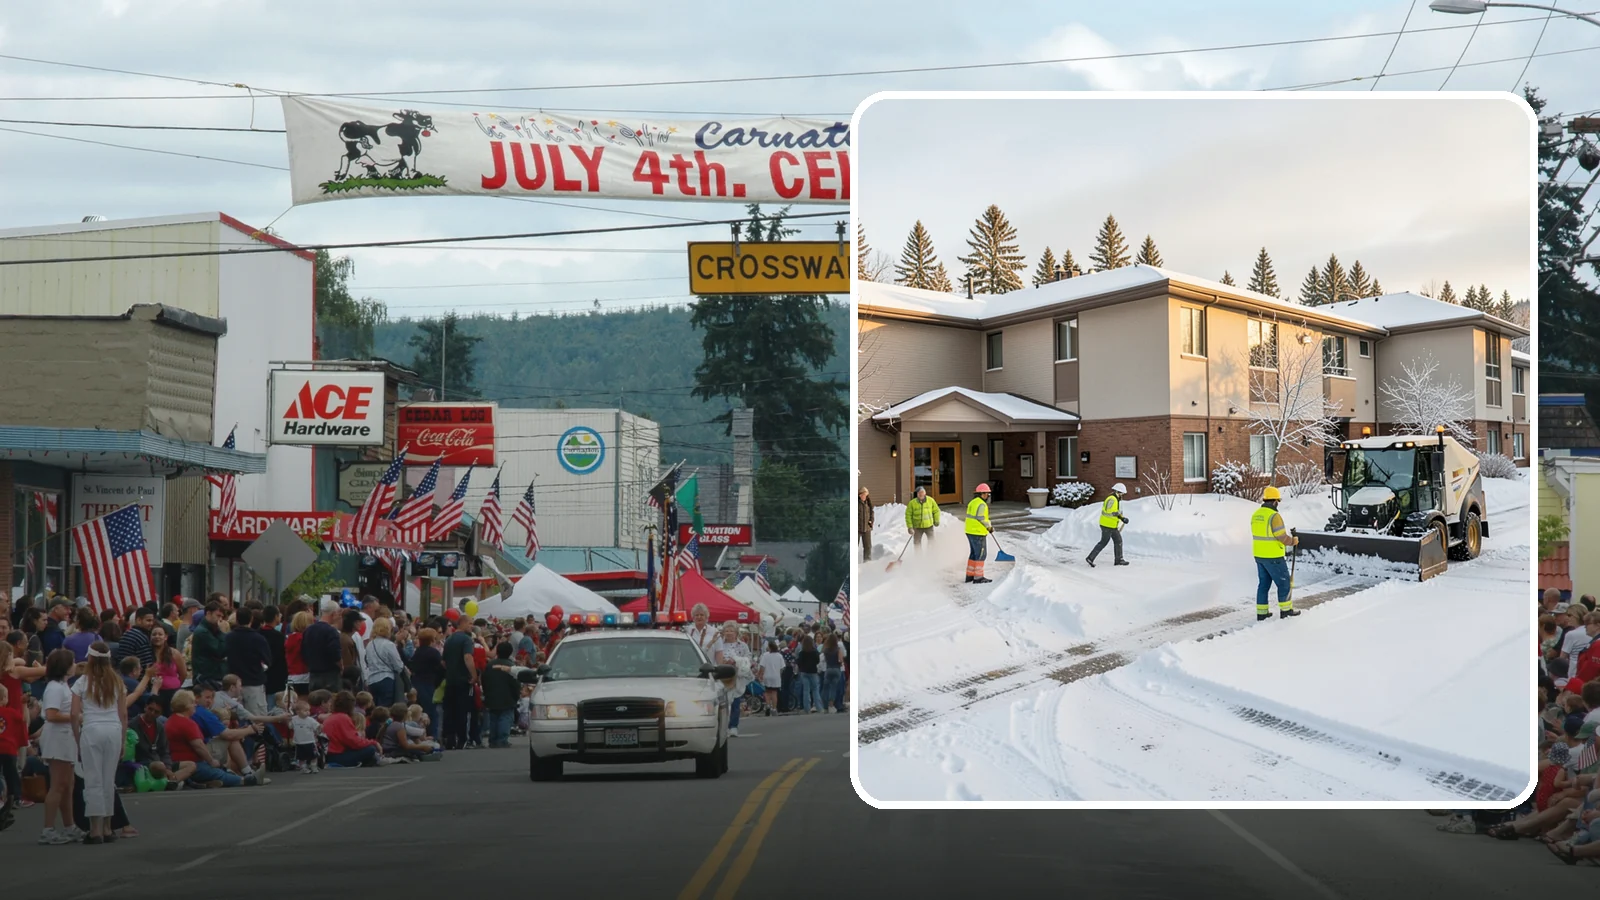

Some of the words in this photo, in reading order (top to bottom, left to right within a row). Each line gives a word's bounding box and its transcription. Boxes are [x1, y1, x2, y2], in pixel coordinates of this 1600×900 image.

[481, 141, 605, 192] JULY
[632, 150, 746, 198] 4th.
[697, 254, 850, 280] CROSSWA
[283, 380, 373, 419] ACE
[406, 409, 452, 422] CEDAR
[461, 409, 485, 422] LOG
[283, 421, 370, 436] Hardware
[83, 485, 93, 494] St.
[96, 485, 124, 495] Vincent
[126, 486, 135, 495] de
[138, 486, 155, 495] Paul
[688, 526, 741, 535] CRNATION
[699, 535, 730, 543] GLASS
